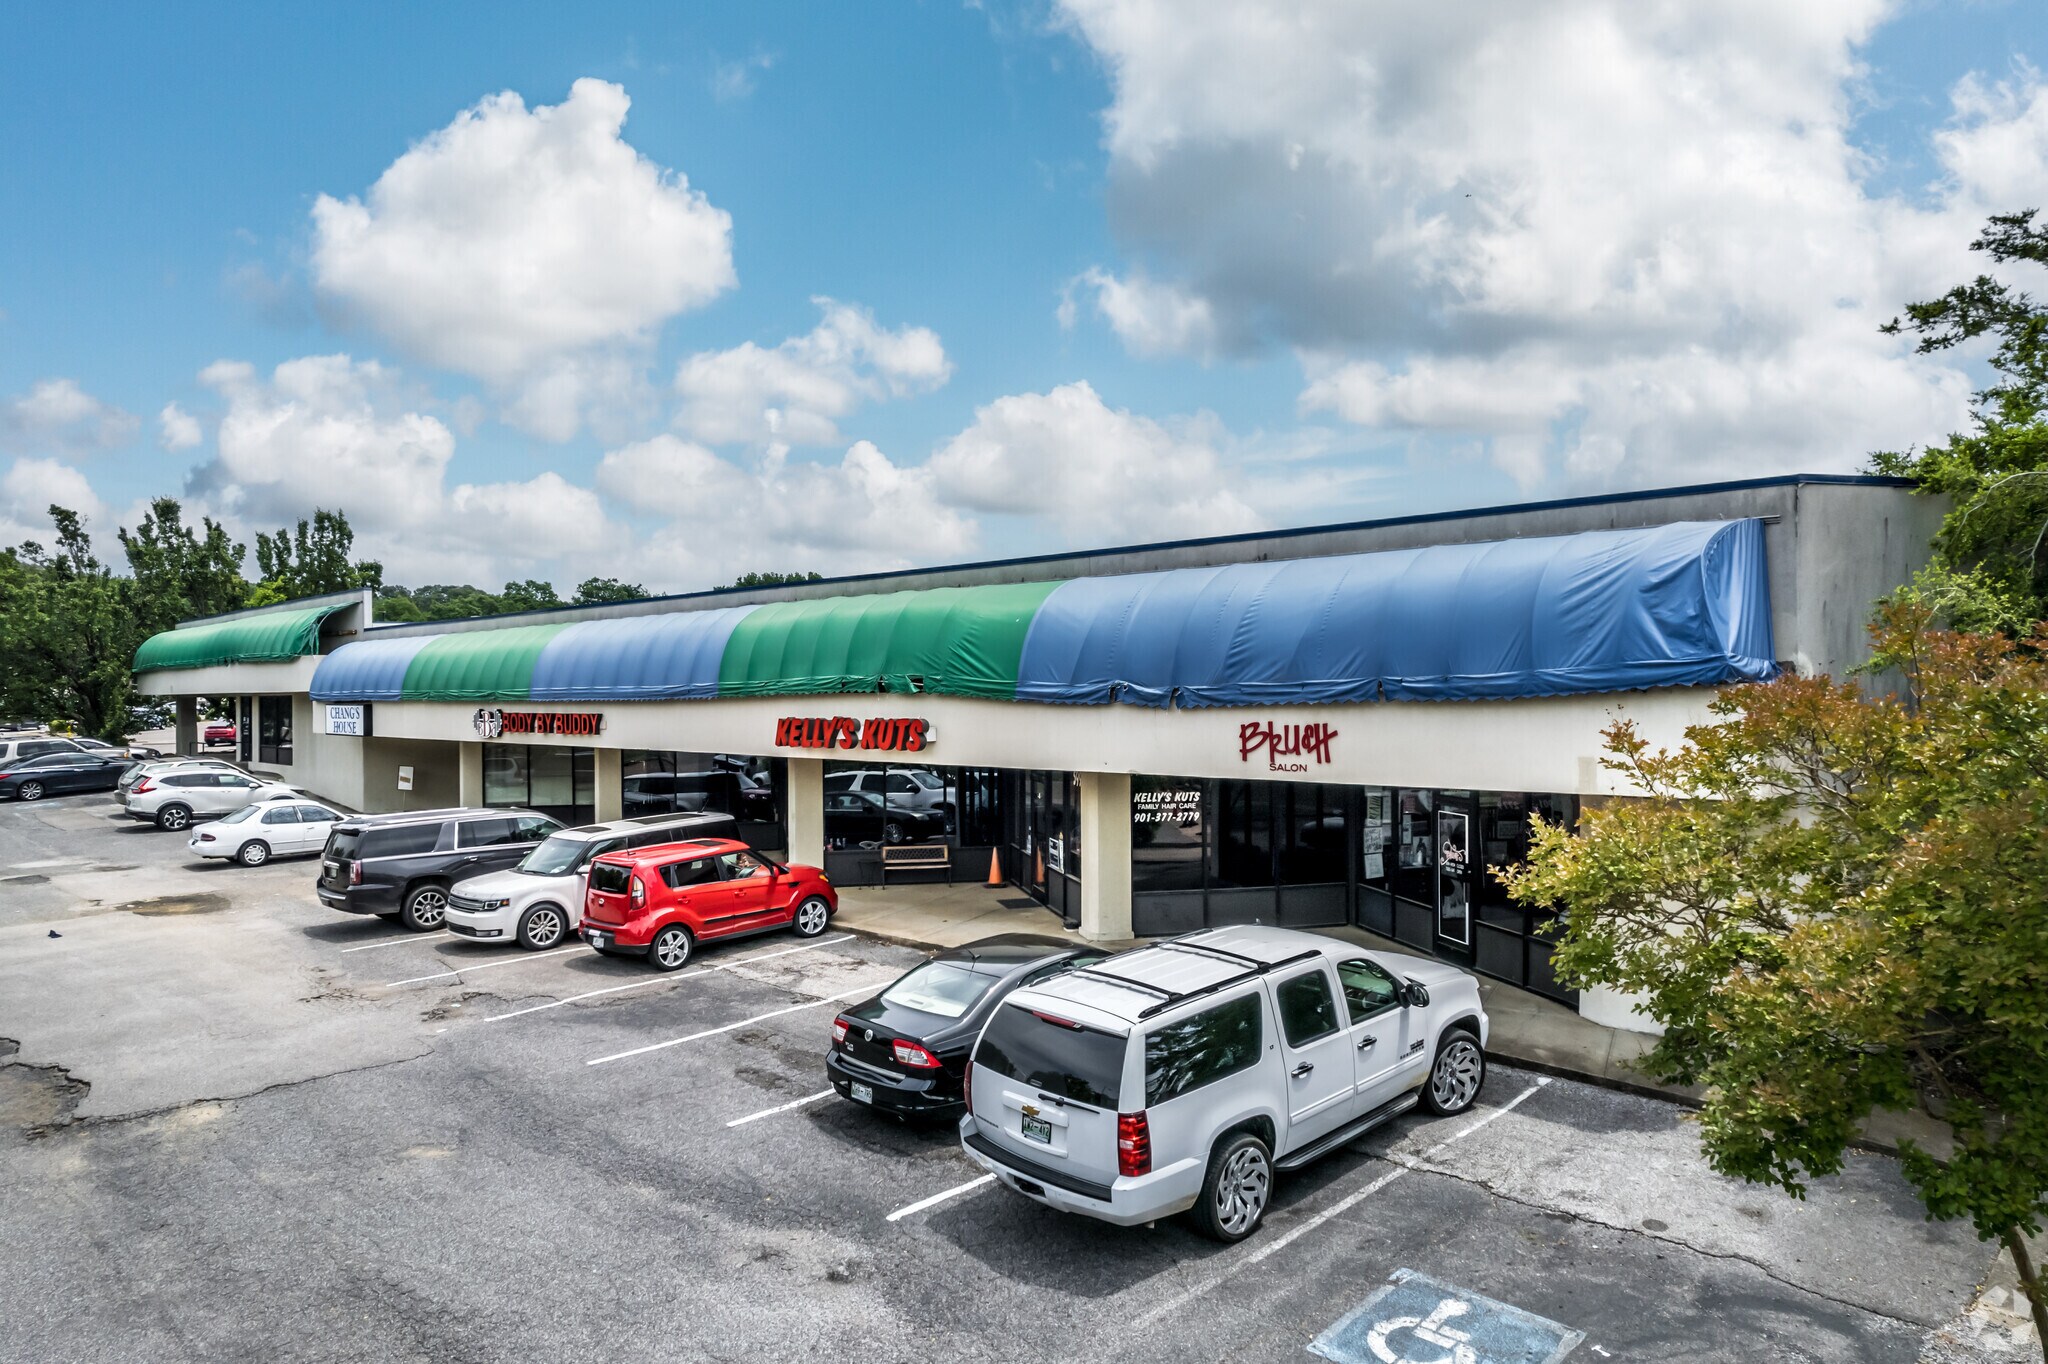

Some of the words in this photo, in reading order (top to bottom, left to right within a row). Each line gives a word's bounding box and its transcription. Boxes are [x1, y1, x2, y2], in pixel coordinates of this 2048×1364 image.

[333, 721, 357, 734] HOUSE
[502, 712, 533, 733] BODY
[536, 713, 553, 734] BY
[555, 713, 599, 736] BUDDY
[775, 716, 859, 750] KELLY'S
[861, 718, 927, 752] KUTS
[1269, 763, 1307, 773] SALON
[1133, 792, 1172, 803] KELLY'S
[1174, 791, 1201, 802] KUTS
[1134, 811, 1200, 823] 901-377-2779
